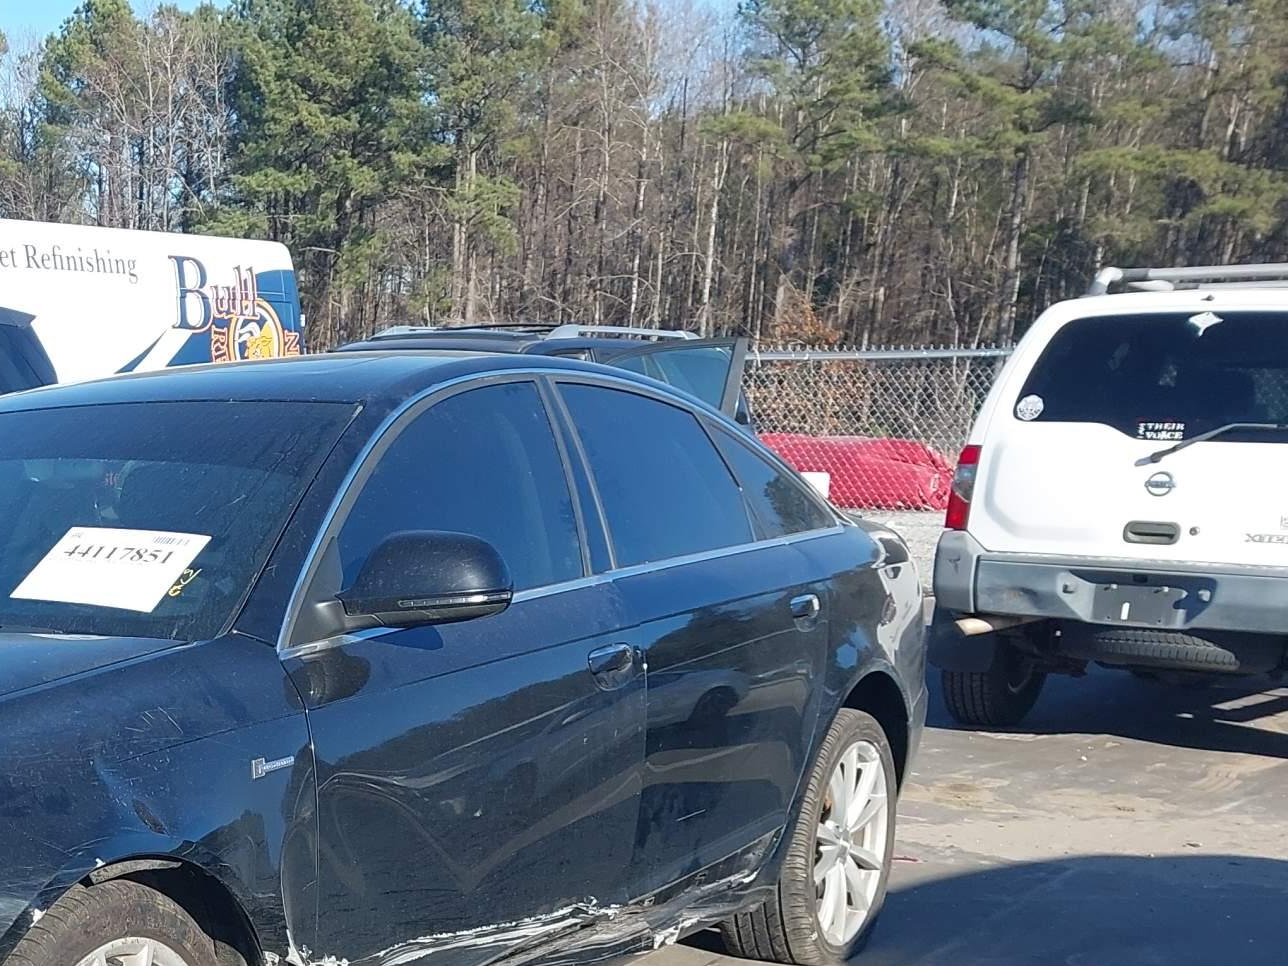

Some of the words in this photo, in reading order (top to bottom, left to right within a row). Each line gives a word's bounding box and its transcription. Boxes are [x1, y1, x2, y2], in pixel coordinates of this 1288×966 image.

[23, 243, 139, 285] Refinishing
[167, 254, 261, 333] Bull
[1146, 422, 1186, 431] THEIR
[63, 543, 175, 565] 44117851
